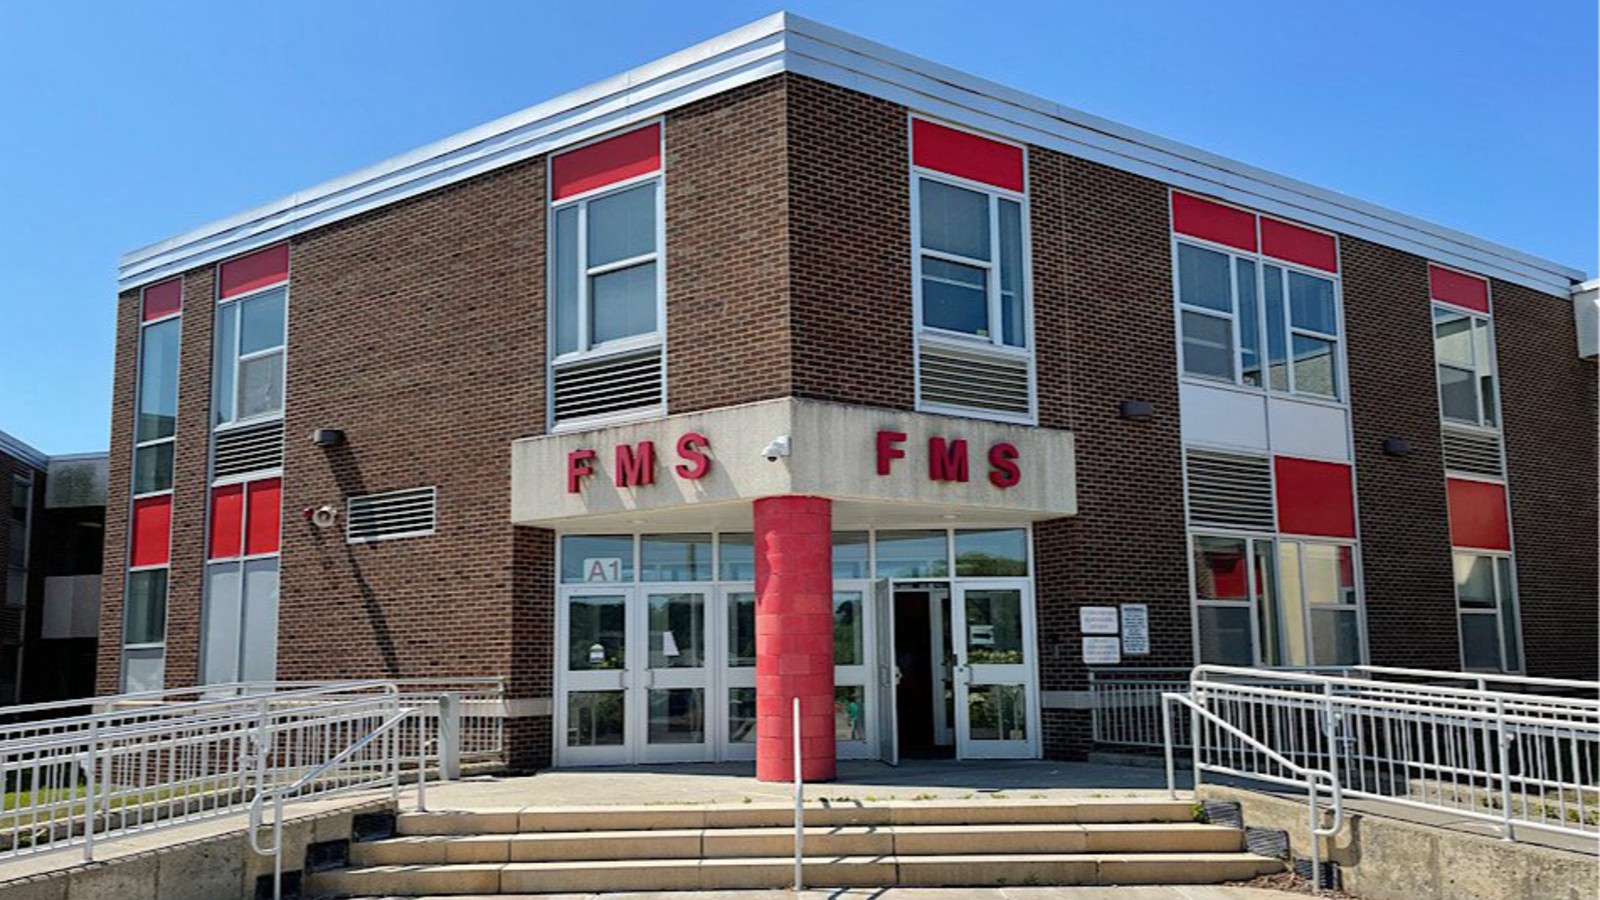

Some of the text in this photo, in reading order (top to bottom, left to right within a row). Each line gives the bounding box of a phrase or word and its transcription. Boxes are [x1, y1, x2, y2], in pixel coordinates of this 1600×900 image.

[568, 432, 711, 494] FMS
[876, 431, 1021, 488] FMS
[587, 560, 619, 582] A1
